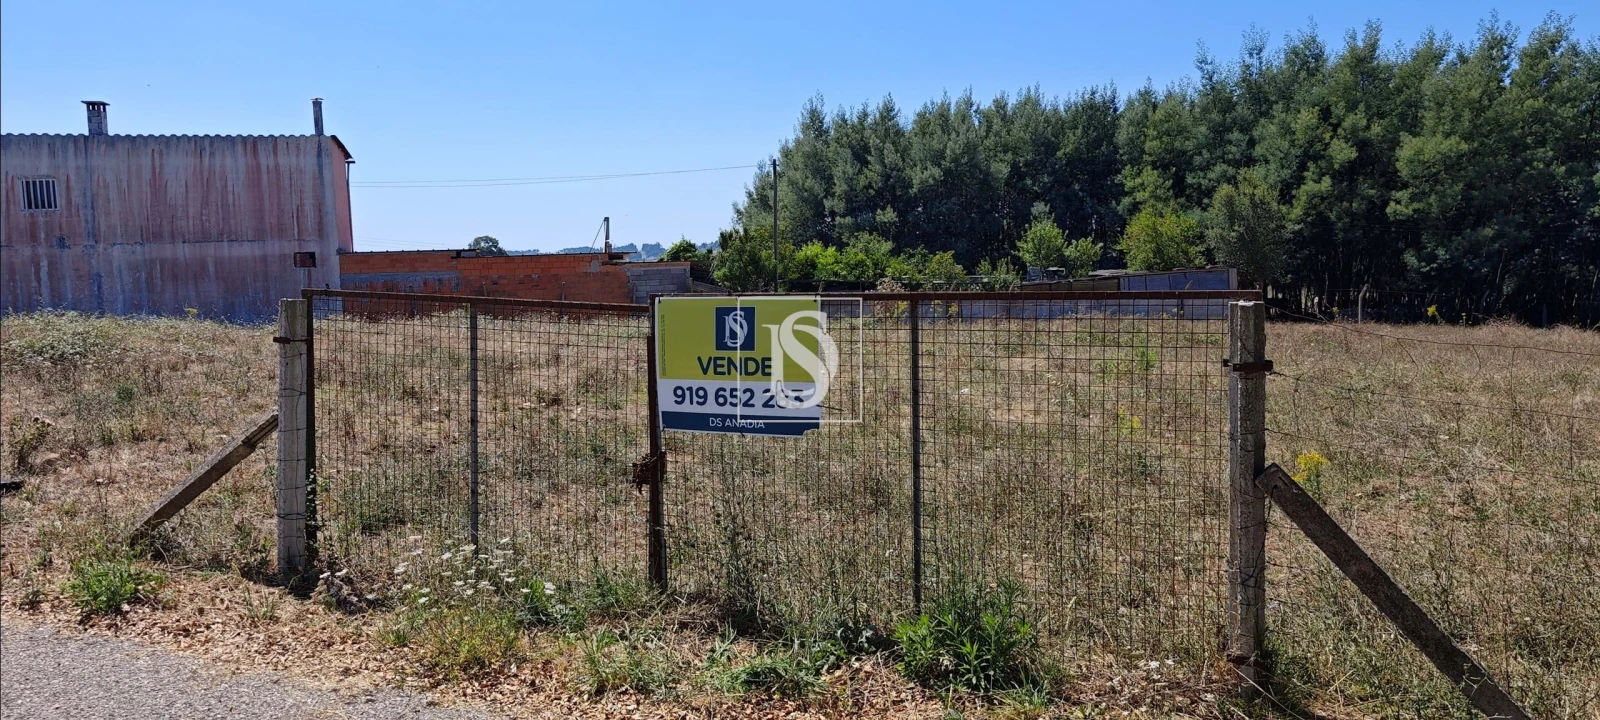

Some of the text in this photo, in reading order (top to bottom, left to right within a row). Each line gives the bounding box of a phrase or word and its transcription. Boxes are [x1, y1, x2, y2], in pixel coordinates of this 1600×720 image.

[697, 356, 774, 376] VENDE
[673, 386, 708, 405] 919
[714, 387, 755, 408] 652
[709, 418, 765, 429] DS ANADIA
